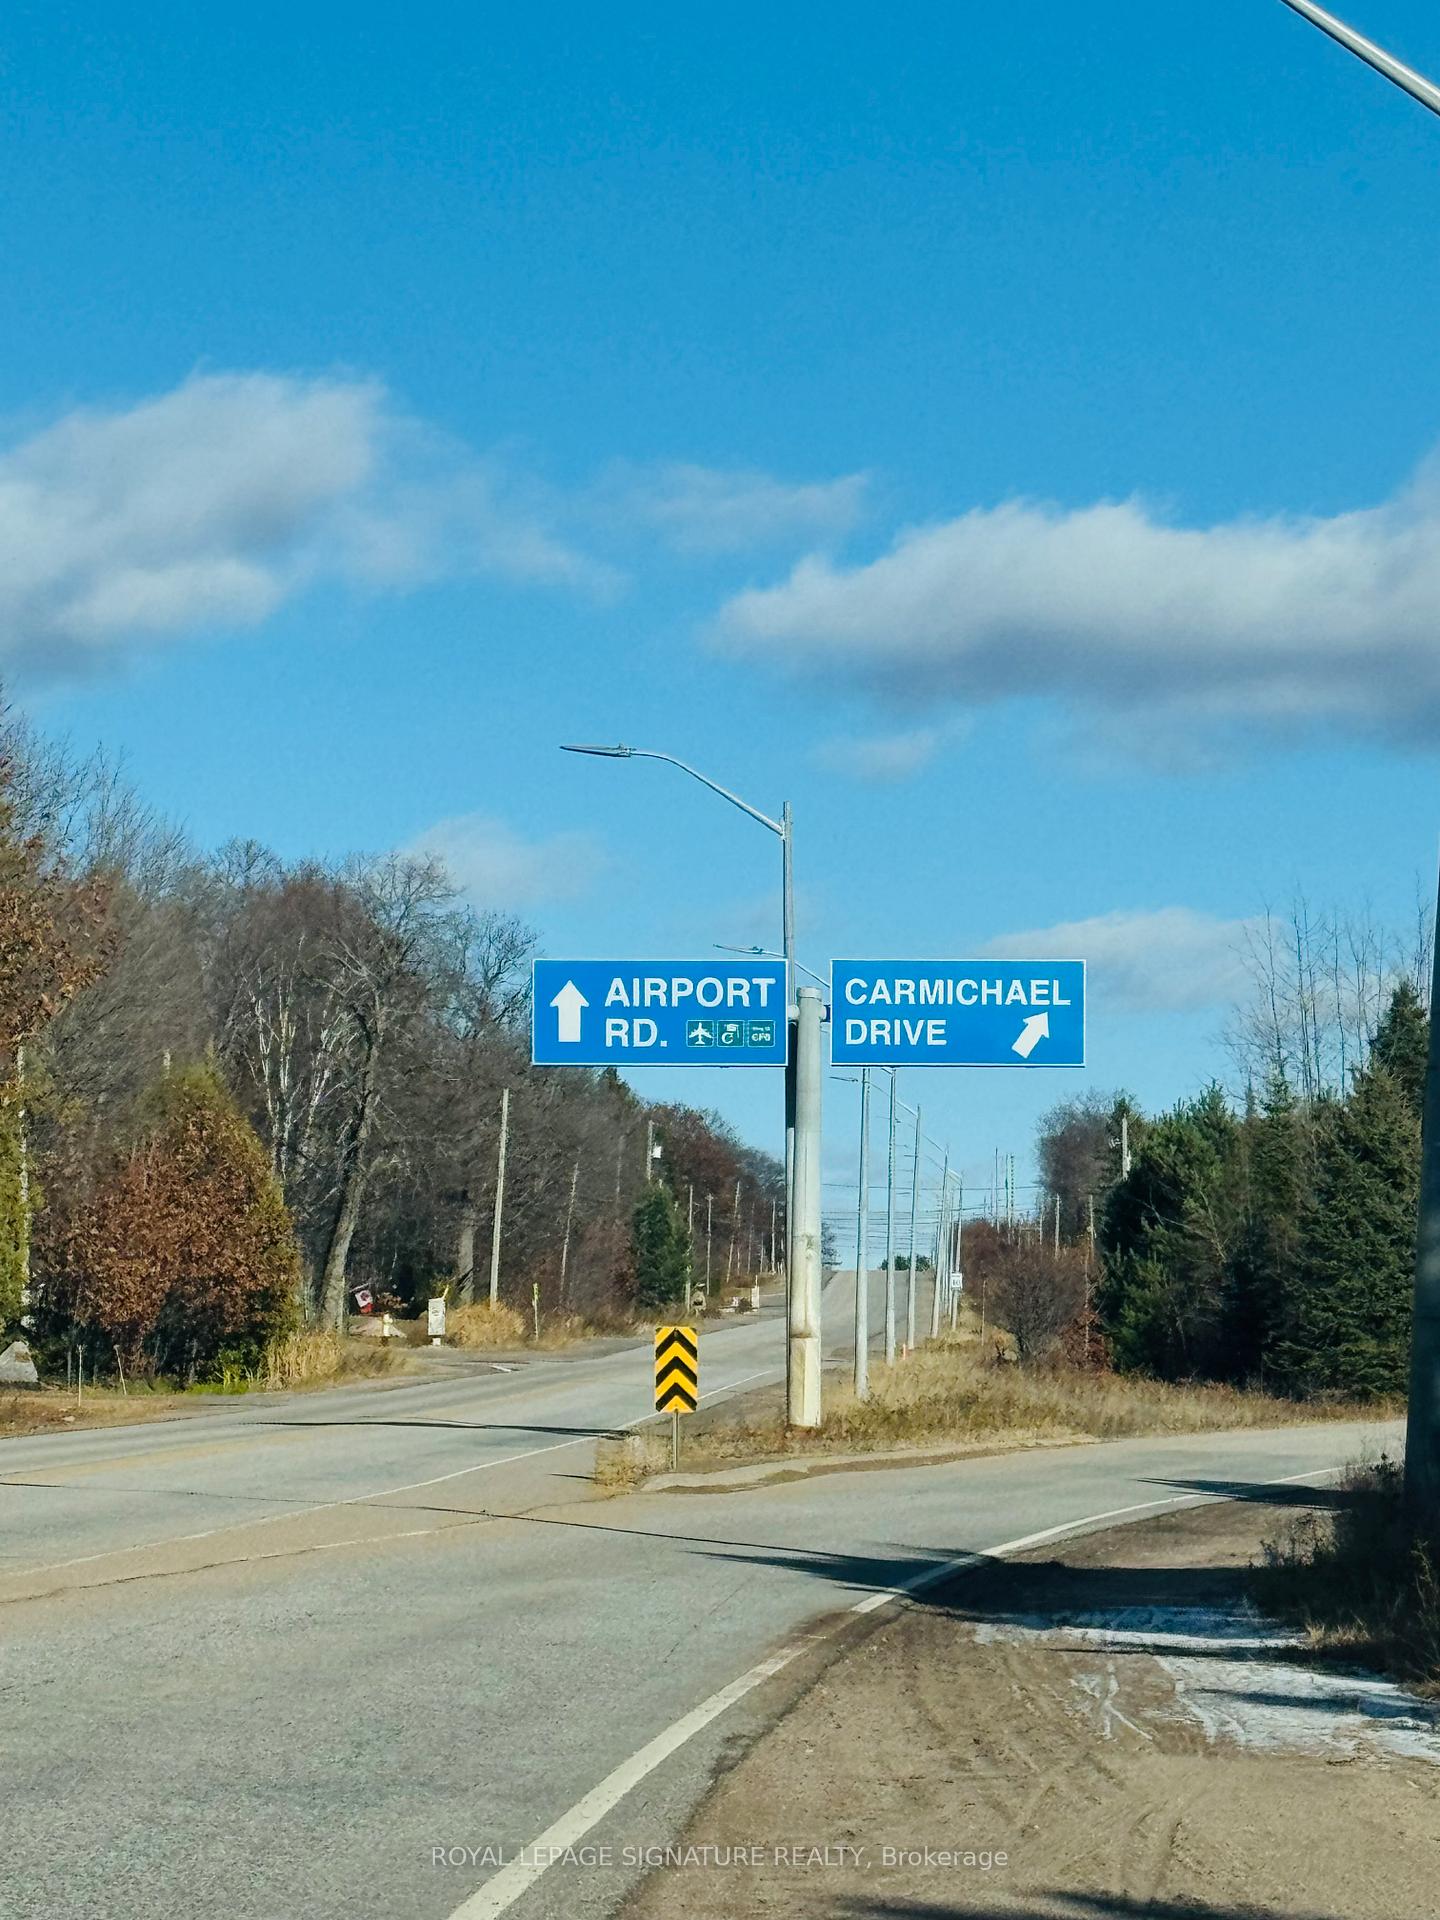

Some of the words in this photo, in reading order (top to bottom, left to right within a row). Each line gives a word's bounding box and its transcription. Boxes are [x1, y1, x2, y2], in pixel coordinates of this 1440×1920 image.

[604, 977, 776, 1008] AIRPORT
[845, 977, 1071, 1007] CARMICHAEL
[605, 1018, 668, 1048] RD.
[845, 1018, 947, 1046] DRIVE
